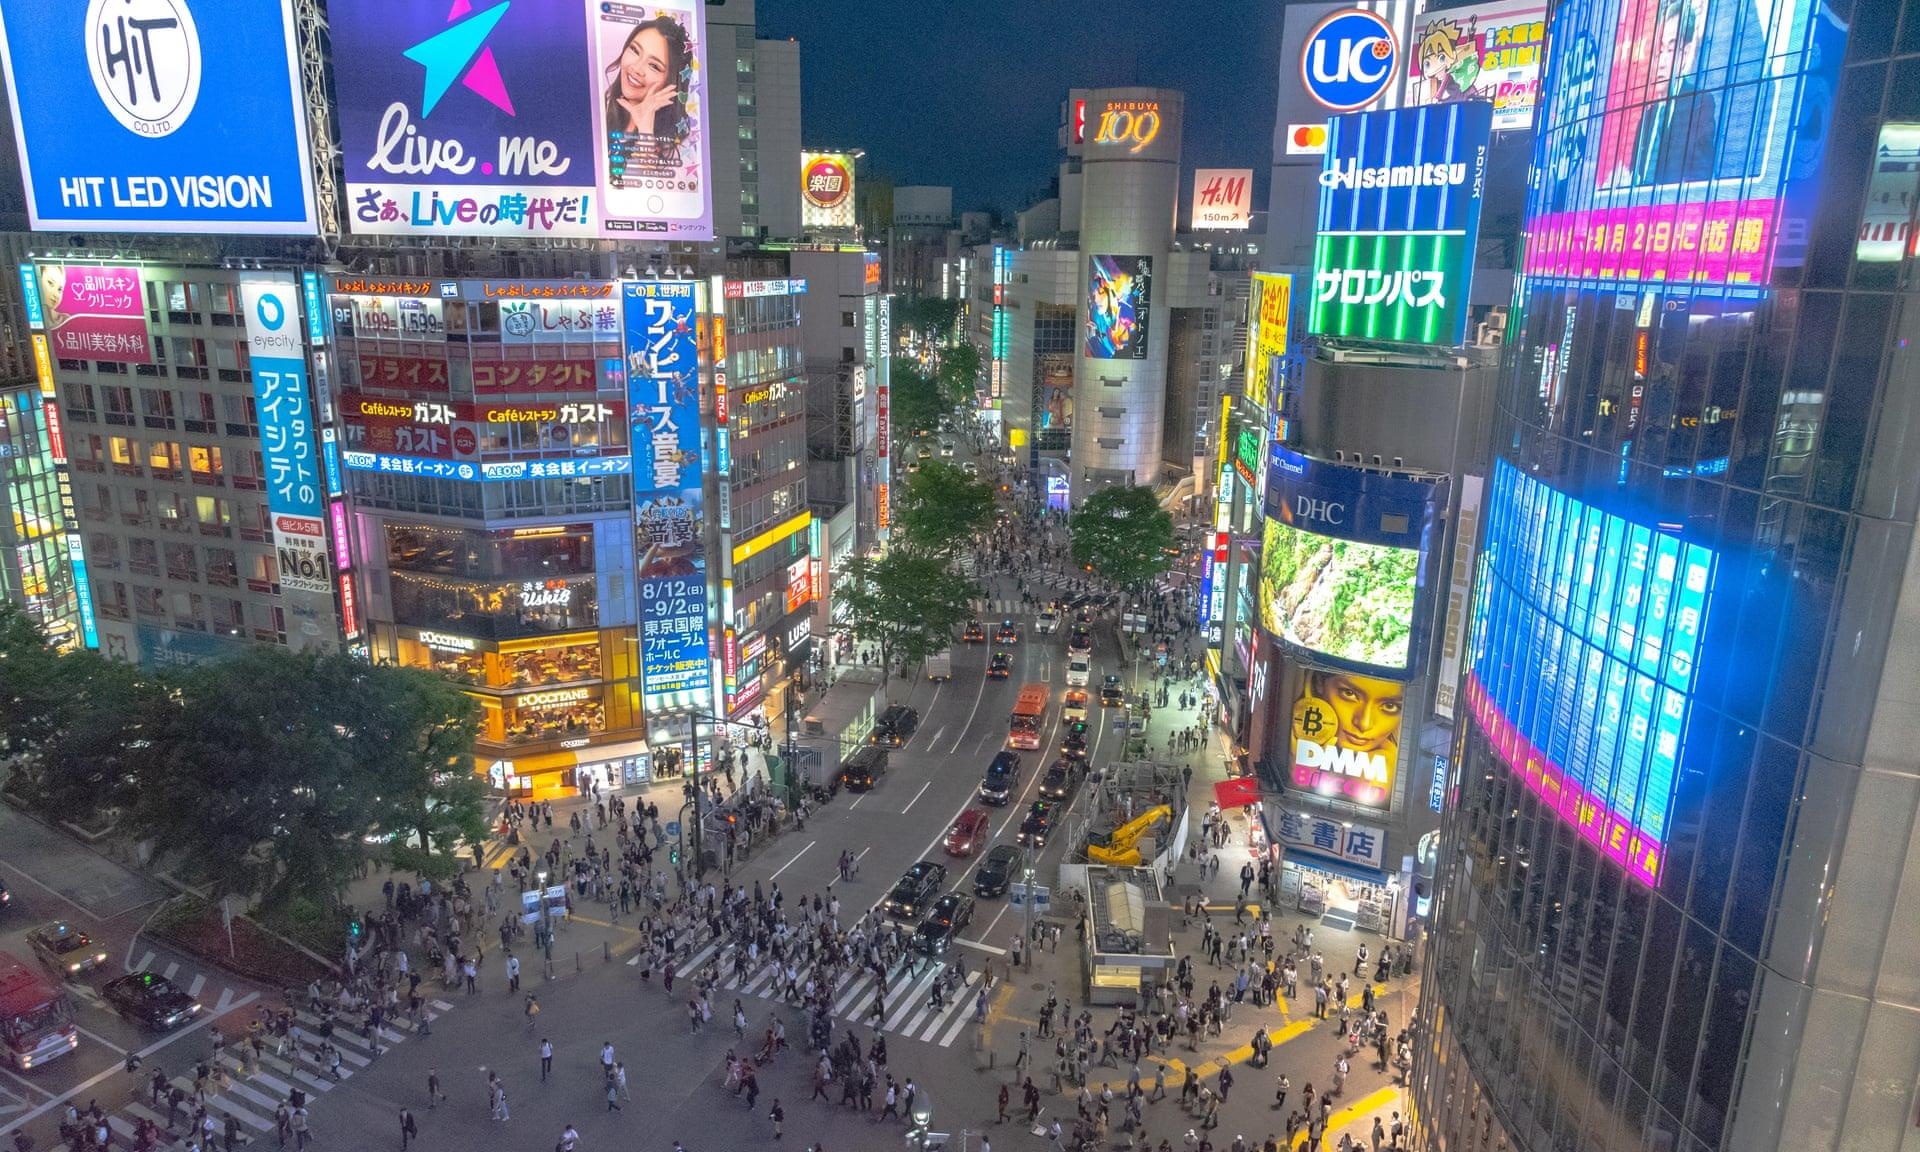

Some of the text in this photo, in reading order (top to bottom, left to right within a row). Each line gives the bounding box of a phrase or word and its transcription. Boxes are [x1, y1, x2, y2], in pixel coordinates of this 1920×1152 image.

[1107, 103, 1159, 111] SHIBUYA
[366, 102, 571, 177] live.me
[1094, 111, 1160, 154] 109
[1318, 157, 1467, 190] Hisamitsu
[1472, 146, 1486, 199] サロンパス
[60, 175, 273, 208] HIT LED VISION
[1201, 176, 1246, 206] H&M
[1203, 212, 1229, 221] 150m
[84, 276, 135, 292] 品川スキン
[336, 279, 432, 294] しゃぶしゃぶバイキング
[484, 284, 614, 298] しゃぶしゃぶバイキング
[1315, 267, 1445, 309] サロンパス
[87, 293, 132, 309] クリニック
[335, 308, 351, 322] 9F
[543, 305, 616, 331] しゃぶ葉
[880, 299, 888, 359] BIC CAMERA
[66, 331, 145, 354] 品川美容外科
[254, 334, 295, 351] eyecity
[474, 363, 592, 386] コンタクト
[769, 382, 787, 402] ガスト
[414, 402, 456, 425] ガスト
[487, 403, 613, 424] Caféレストラン ガスト
[717, 395, 727, 418] ガスト
[258, 371, 291, 504] アイシティ
[284, 372, 315, 505] コンタクトの
[395, 426, 447, 454] ガスト
[457, 438, 475, 448] ガスト
[347, 454, 374, 468] AEON
[380, 457, 456, 477] 英会話イーオン
[487, 465, 523, 479] AEON
[530, 459, 629, 477] 英会話イーオン
[1296, 495, 1345, 525] DHC
[281, 520, 320, 534] 当ビル5階
[277, 547, 330, 582] No.1
[643, 580, 704, 600] 8/12(日)
[644, 615, 704, 637] 東京国際
[788, 616, 811, 647] LUSH
[644, 632, 705, 652] フォーラム
[646, 649, 681, 663] ホールC
[518, 689, 589, 708] L'OCCITANE
[1295, 738, 1389, 784] DMM
[1278, 812, 1375, 859] 堂書店
